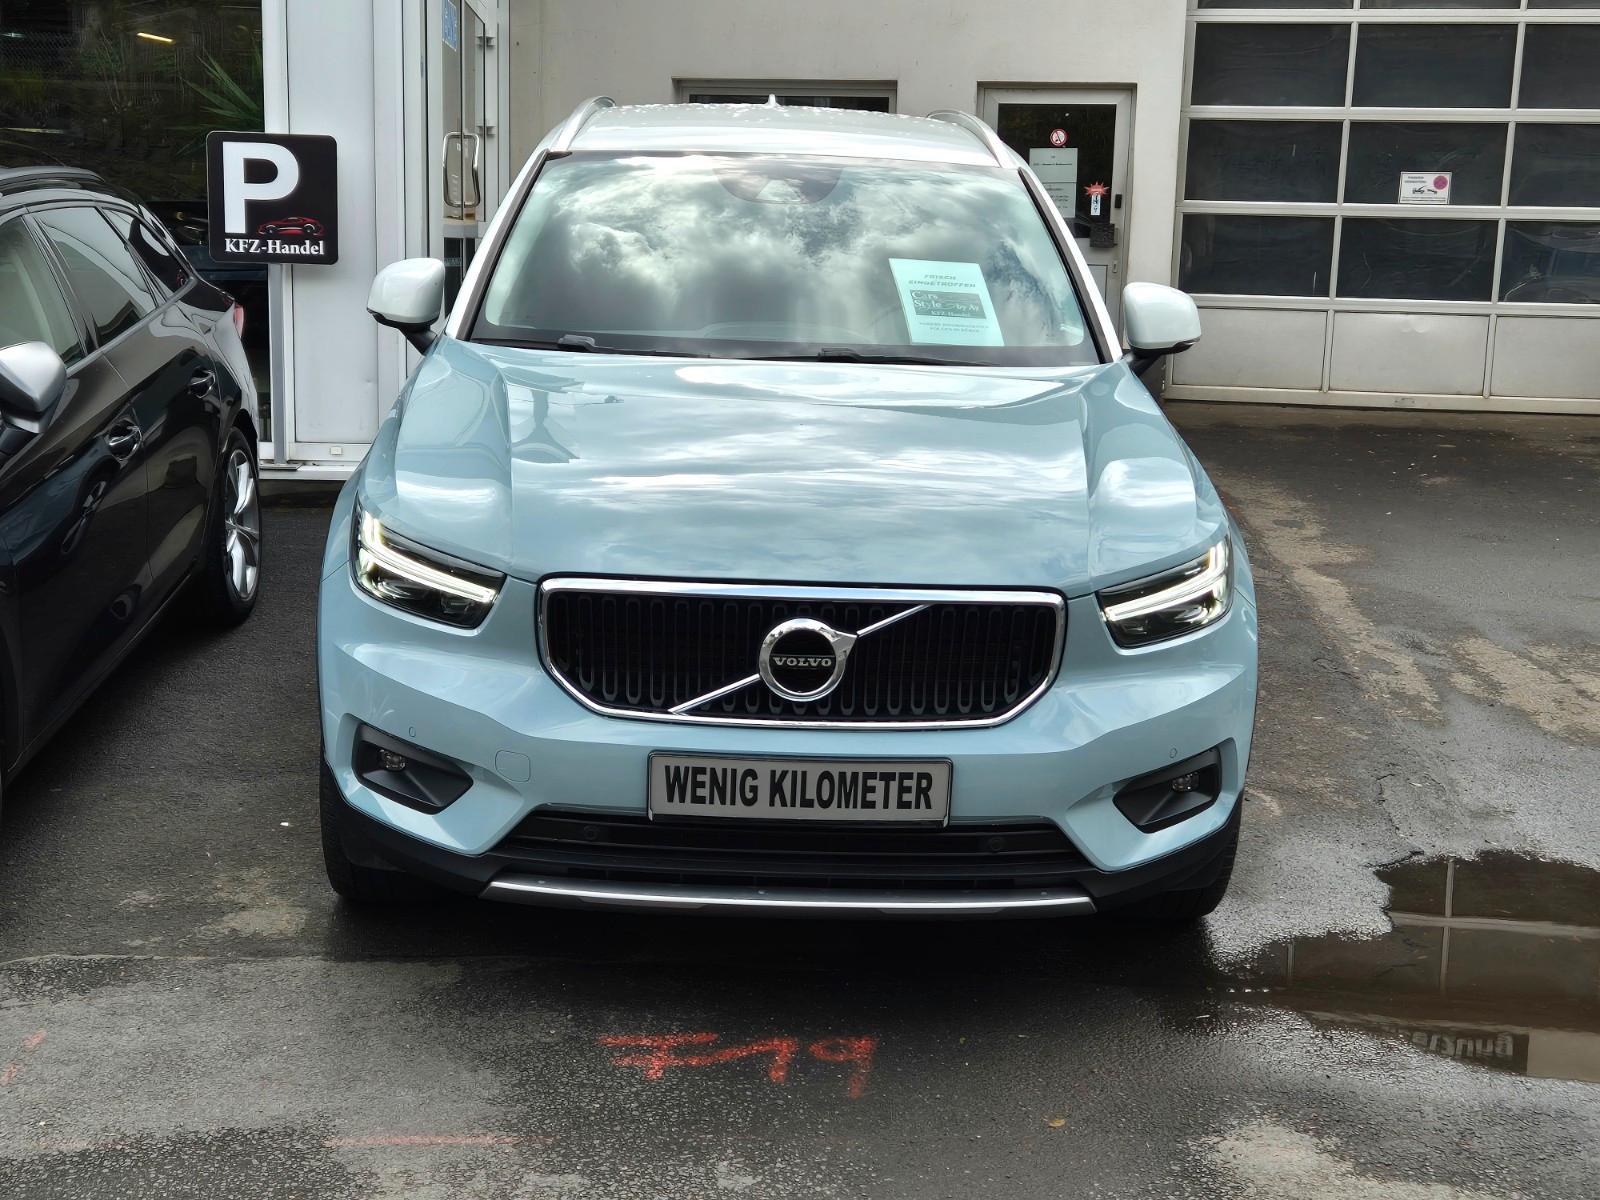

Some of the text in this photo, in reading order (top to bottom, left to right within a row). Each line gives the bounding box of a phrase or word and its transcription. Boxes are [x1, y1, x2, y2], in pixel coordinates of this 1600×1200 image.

[222, 141, 299, 234] P
[224, 238, 325, 255] KFZ-Handel
[913, 299, 942, 310] Style
[772, 657, 832, 667] VOLVO
[664, 765, 933, 810] WENIG KILOMETER
